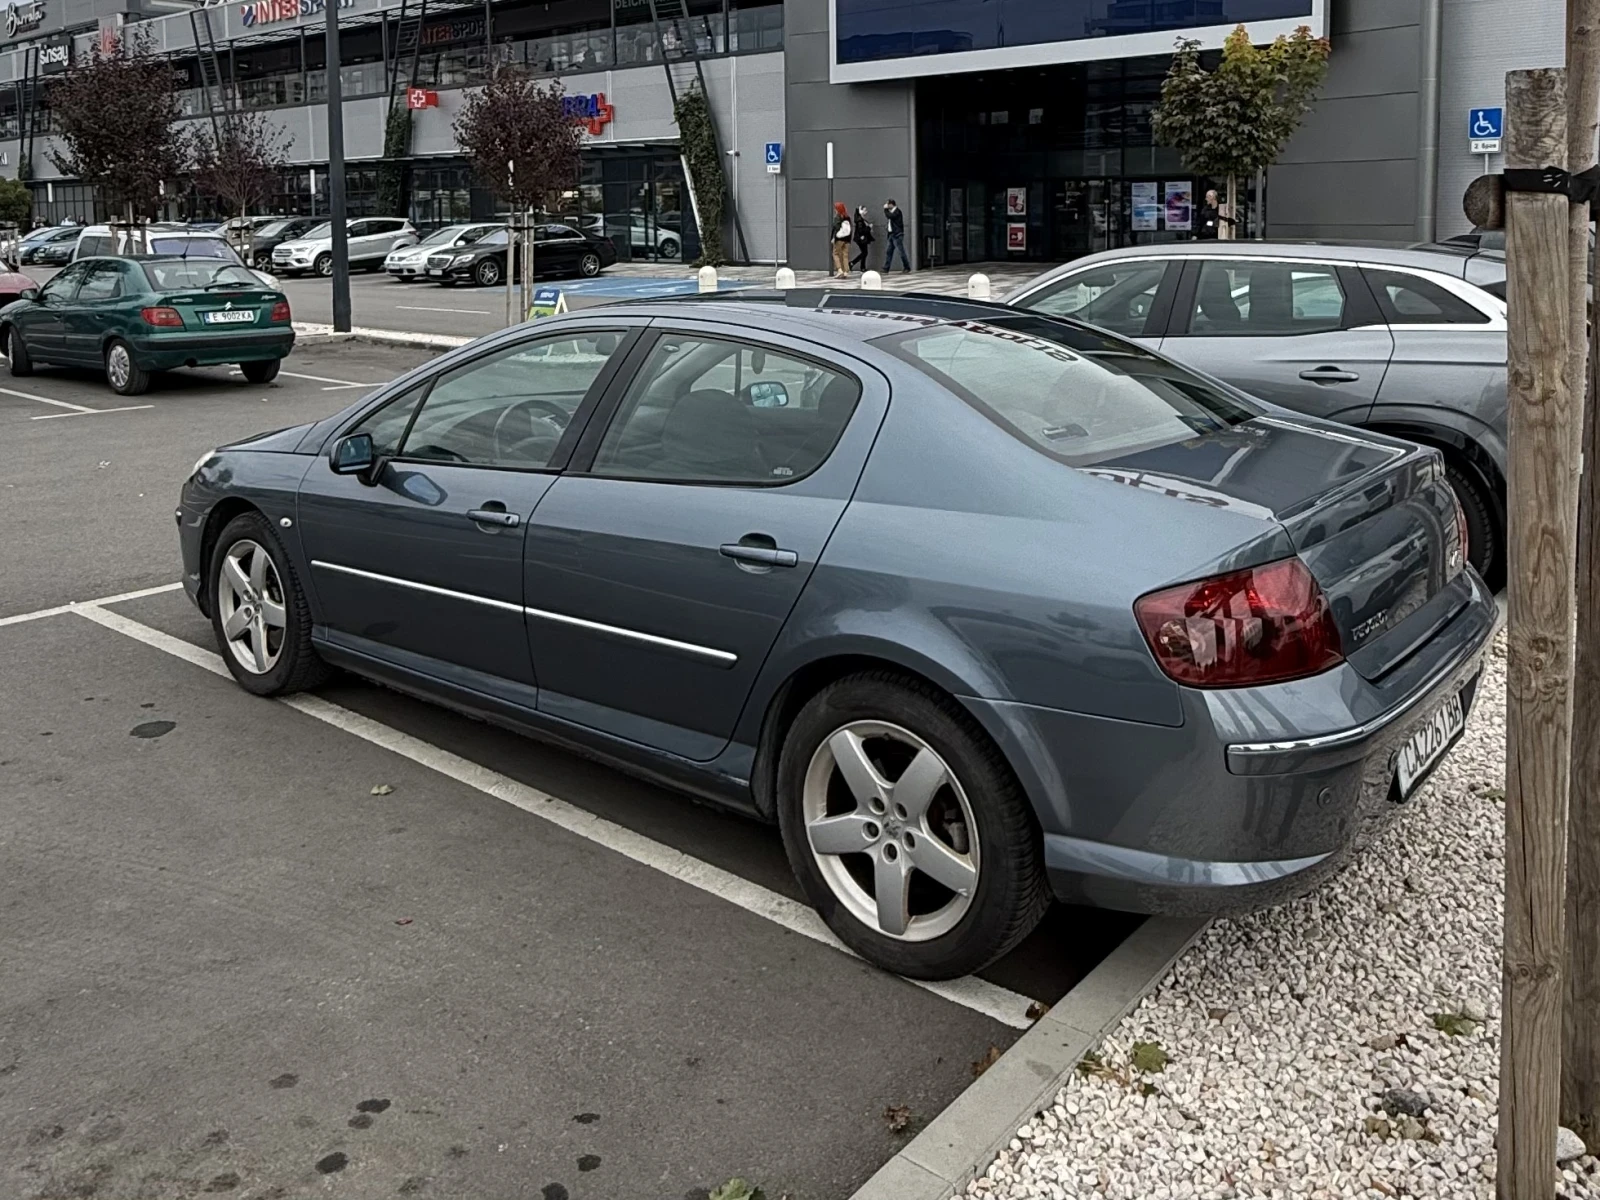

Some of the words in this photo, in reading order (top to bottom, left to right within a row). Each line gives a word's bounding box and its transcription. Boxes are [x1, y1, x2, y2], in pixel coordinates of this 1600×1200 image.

[254, 0, 355, 24] INTERSP
[40, 44, 69, 66] sinsay
[213, 313, 219, 322] E
[221, 311, 241, 321] 9002
[242, 310, 253, 320] KA
